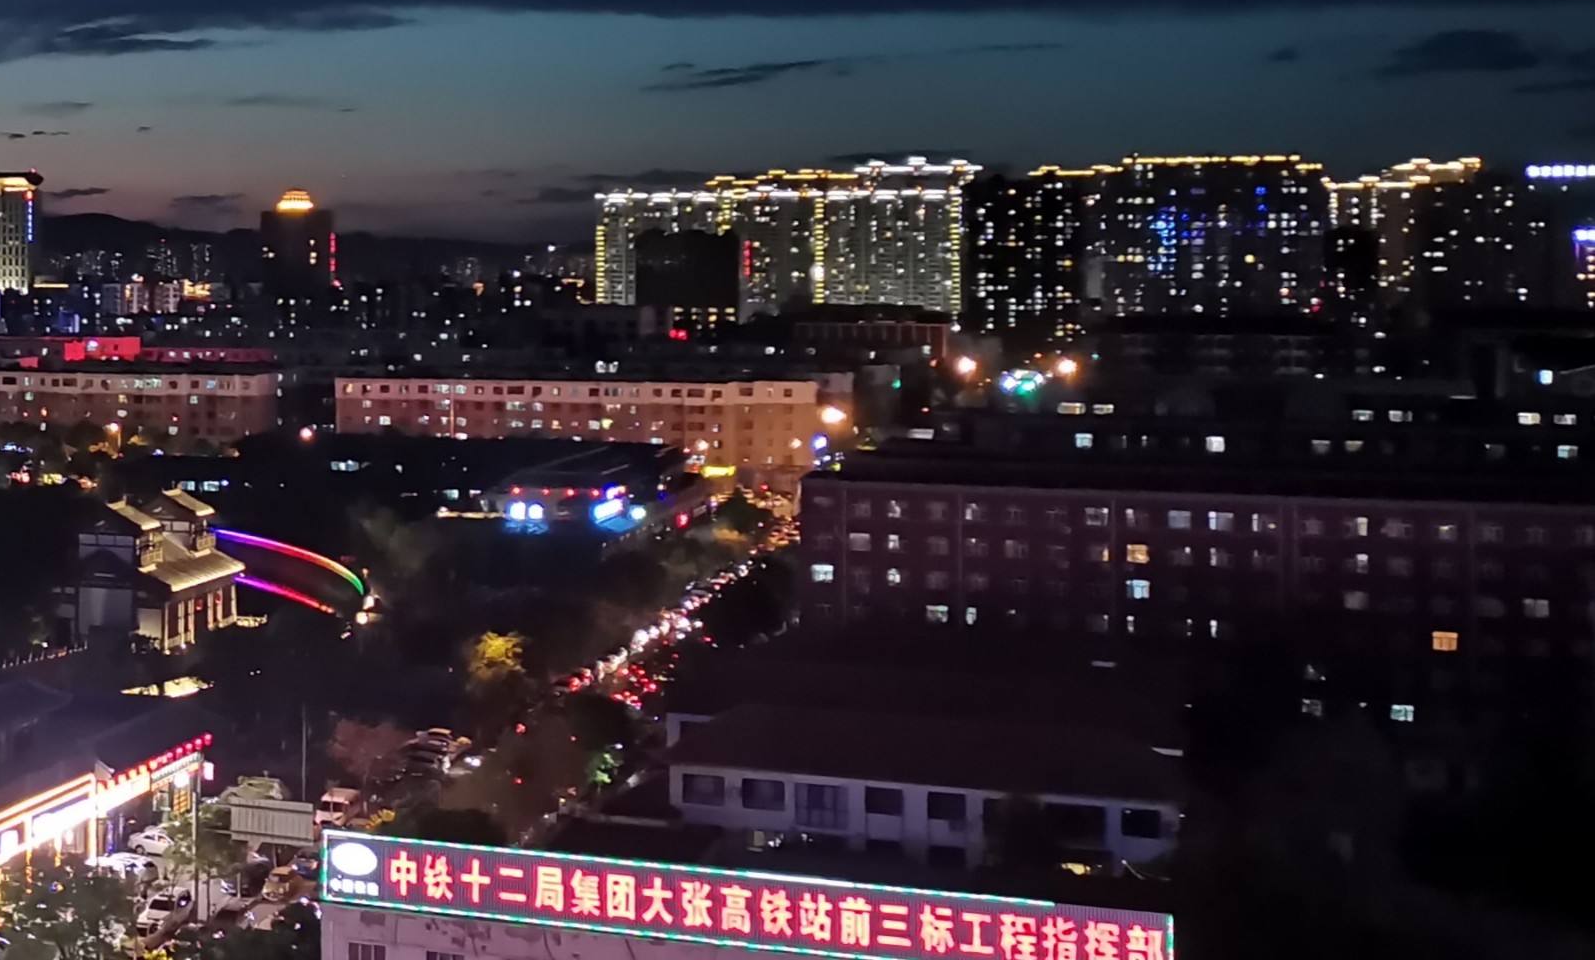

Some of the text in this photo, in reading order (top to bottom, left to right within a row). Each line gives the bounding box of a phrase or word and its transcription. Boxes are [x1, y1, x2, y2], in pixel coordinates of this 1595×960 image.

[389, 850, 1165, 960] 中铁十二局集团大张高铁站前三标工程指挥部
